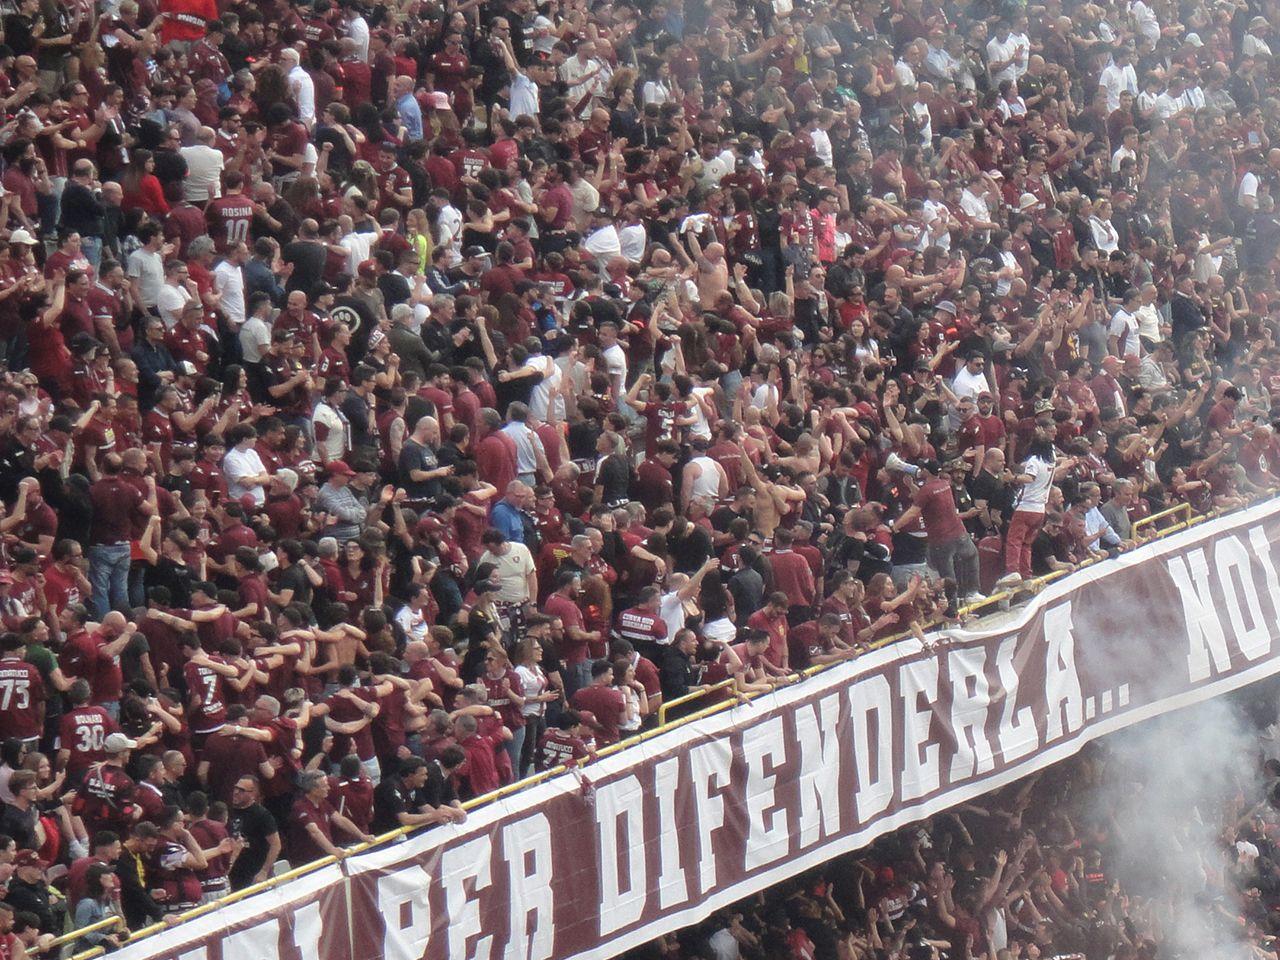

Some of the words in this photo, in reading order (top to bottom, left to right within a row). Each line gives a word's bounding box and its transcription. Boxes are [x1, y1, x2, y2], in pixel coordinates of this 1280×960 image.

[0, 680, 30, 711] 73
[76, 724, 105, 753] 30
[595, 601, 1130, 937] DIFENDERLA...
